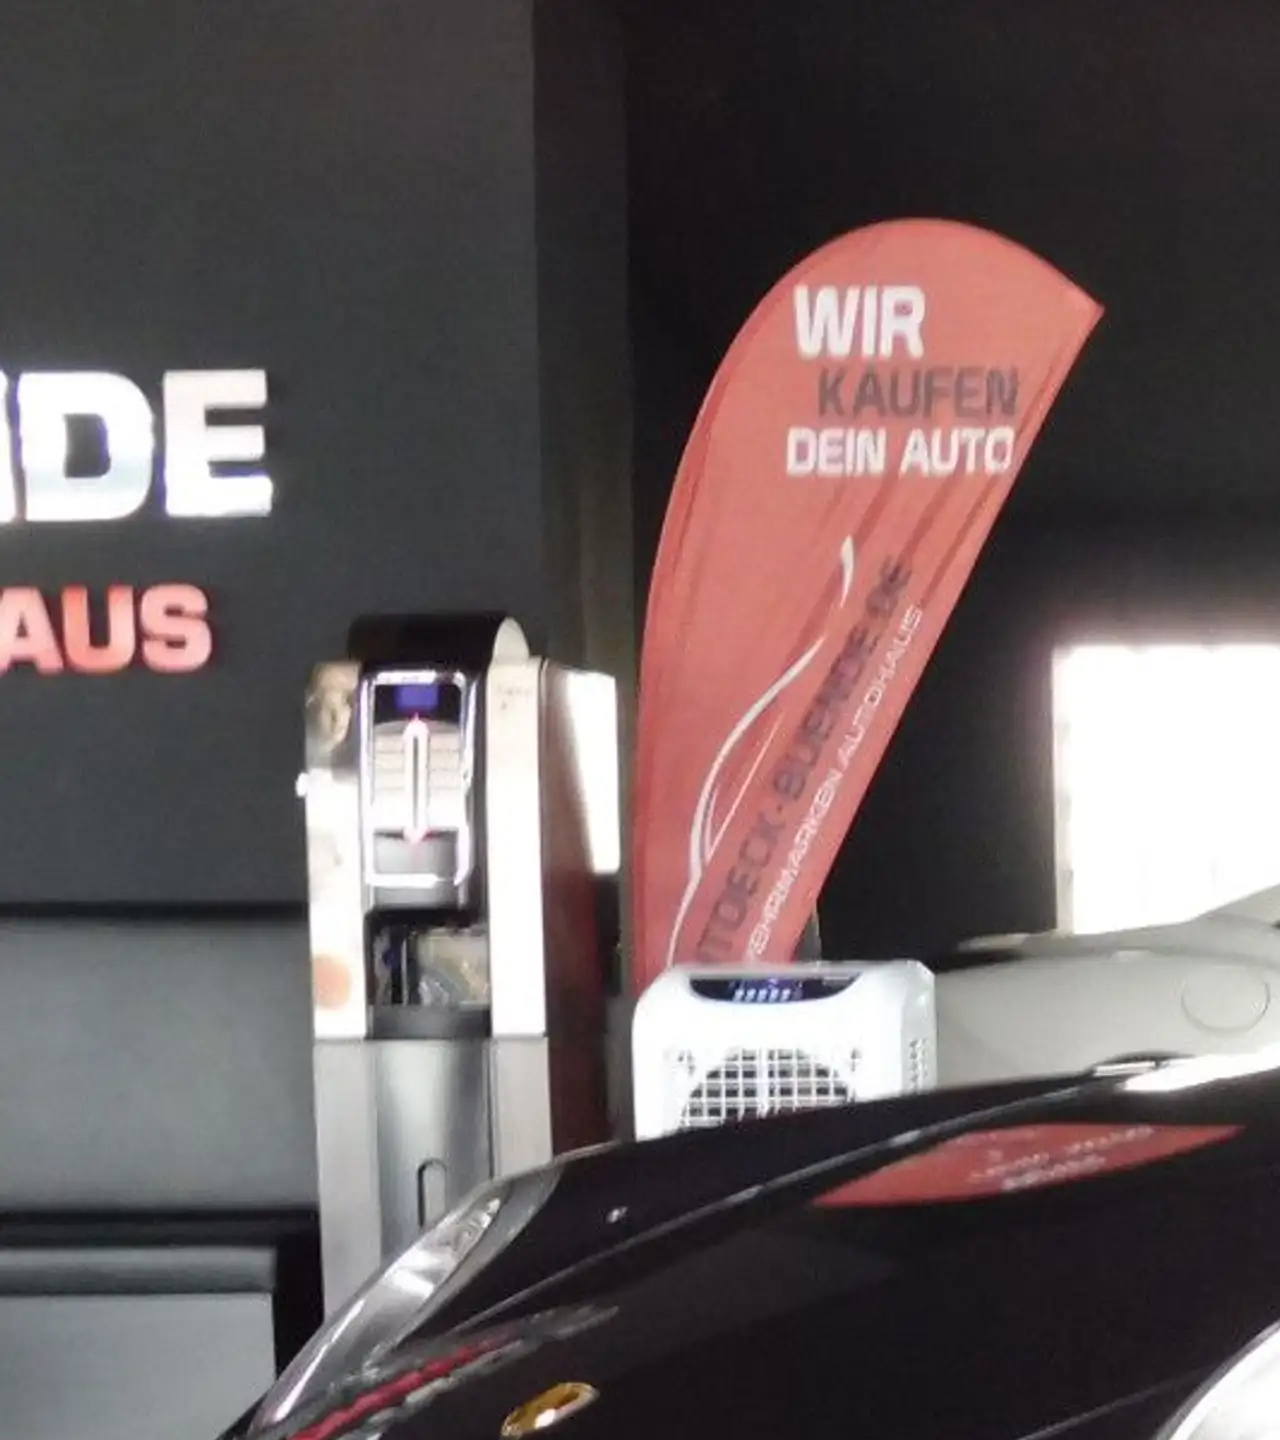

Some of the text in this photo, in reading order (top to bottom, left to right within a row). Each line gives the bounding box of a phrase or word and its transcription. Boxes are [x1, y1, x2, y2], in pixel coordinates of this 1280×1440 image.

[794, 284, 926, 361] WIR
[818, 367, 1020, 418] KAUFEN
[786, 427, 1015, 477] DEIN AUTO
[0, 583, 212, 675] AUS
[837, 603, 923, 770] AUTOHAUS
